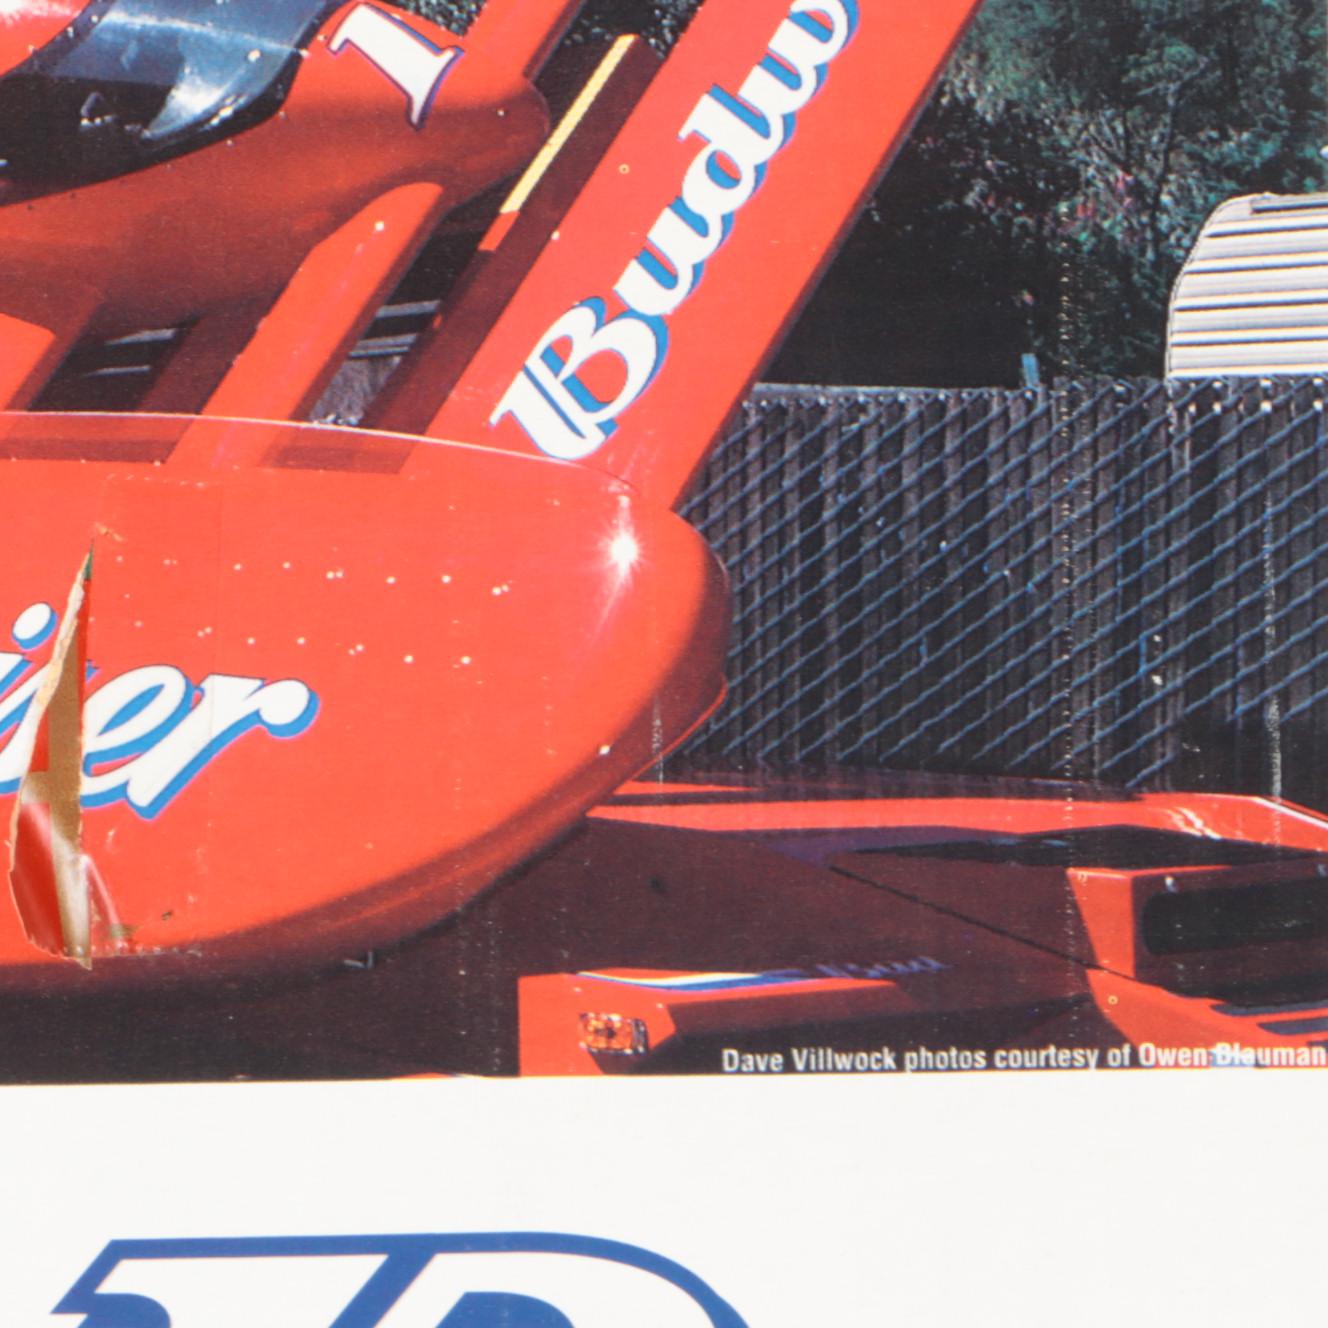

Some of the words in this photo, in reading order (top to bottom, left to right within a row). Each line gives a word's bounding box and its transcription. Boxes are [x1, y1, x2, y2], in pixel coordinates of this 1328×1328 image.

[327, 1, 465, 132] 1
[721, 1047, 785, 1073] Dave
[789, 1046, 898, 1072] Villwock
[904, 1044, 988, 1074] photos
[993, 1043, 1100, 1073] courtesy
[1106, 1041, 1133, 1068] of
[1137, 1042, 1209, 1068] Owen
